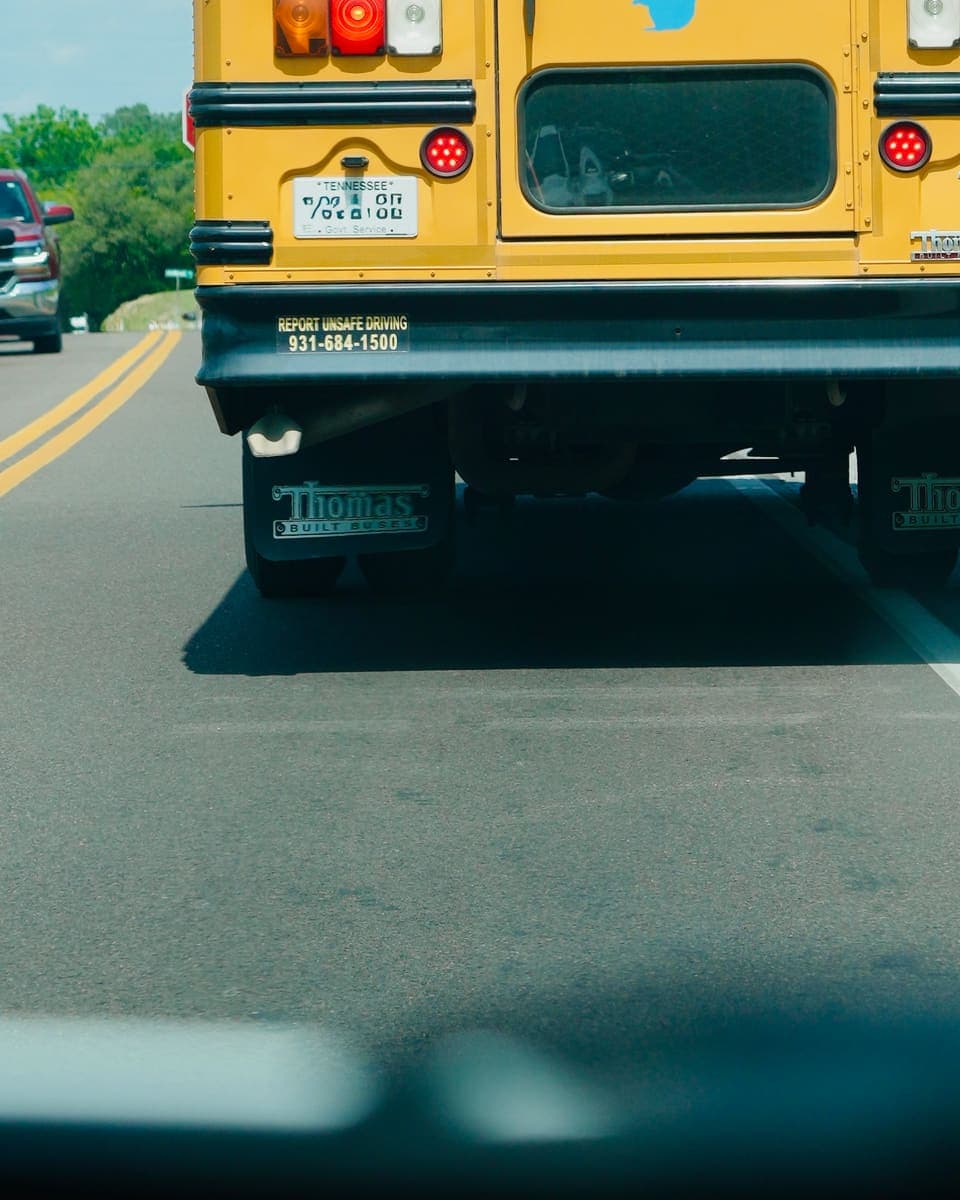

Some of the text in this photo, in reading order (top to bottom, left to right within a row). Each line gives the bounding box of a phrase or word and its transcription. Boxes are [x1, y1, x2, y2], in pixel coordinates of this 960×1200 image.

[324, 181, 388, 191] TENNESSEE
[278, 316, 408, 332] REPORT UNSAFE DRIVING
[289, 334, 398, 351] 931-684-1500
[272, 481, 430, 520] Thomas
[290, 522, 338, 532] BUILT
[909, 516, 958, 526] BUILT
